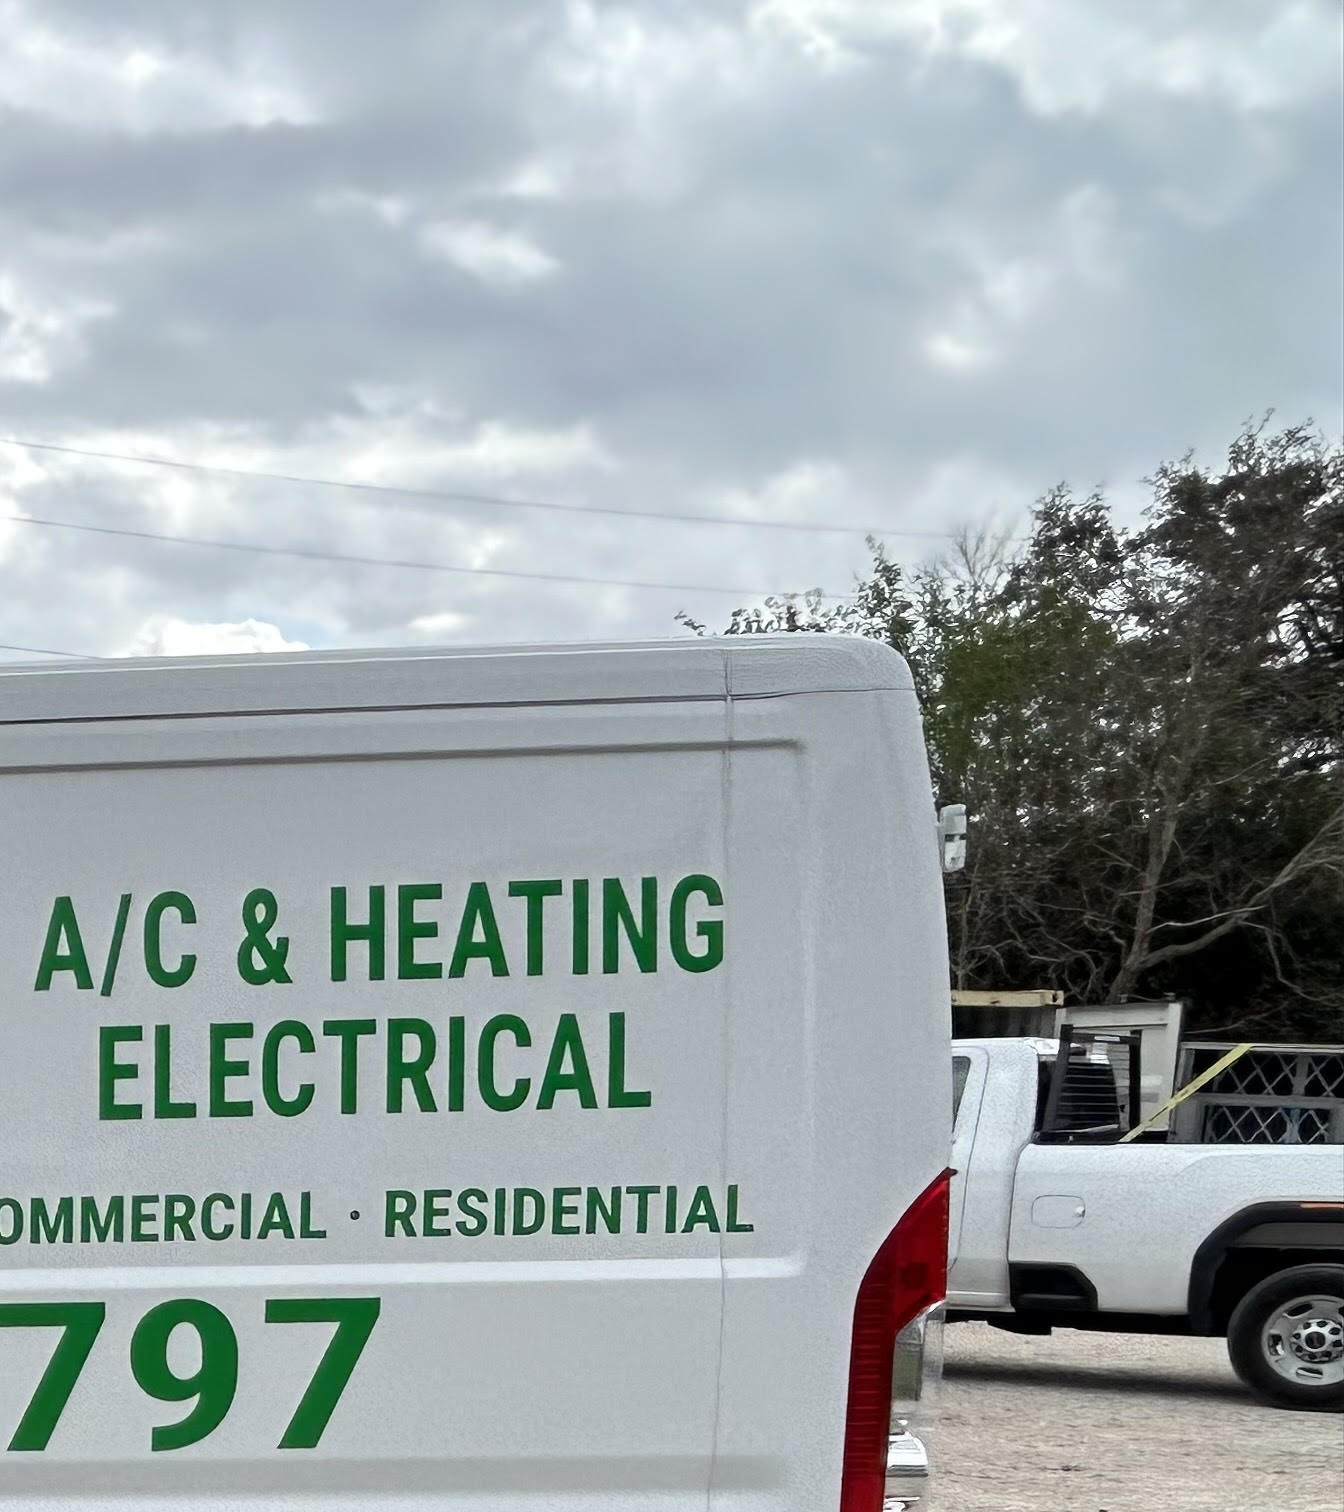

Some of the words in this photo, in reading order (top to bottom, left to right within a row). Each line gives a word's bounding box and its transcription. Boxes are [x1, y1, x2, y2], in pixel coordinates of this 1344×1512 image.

[34, 891, 197, 997] A/C
[237, 888, 293, 985] &
[331, 874, 723, 982] HEATING
[99, 1012, 651, 1120] ELECTRICAL
[385, 1185, 754, 1237] RESIDENTIAL
